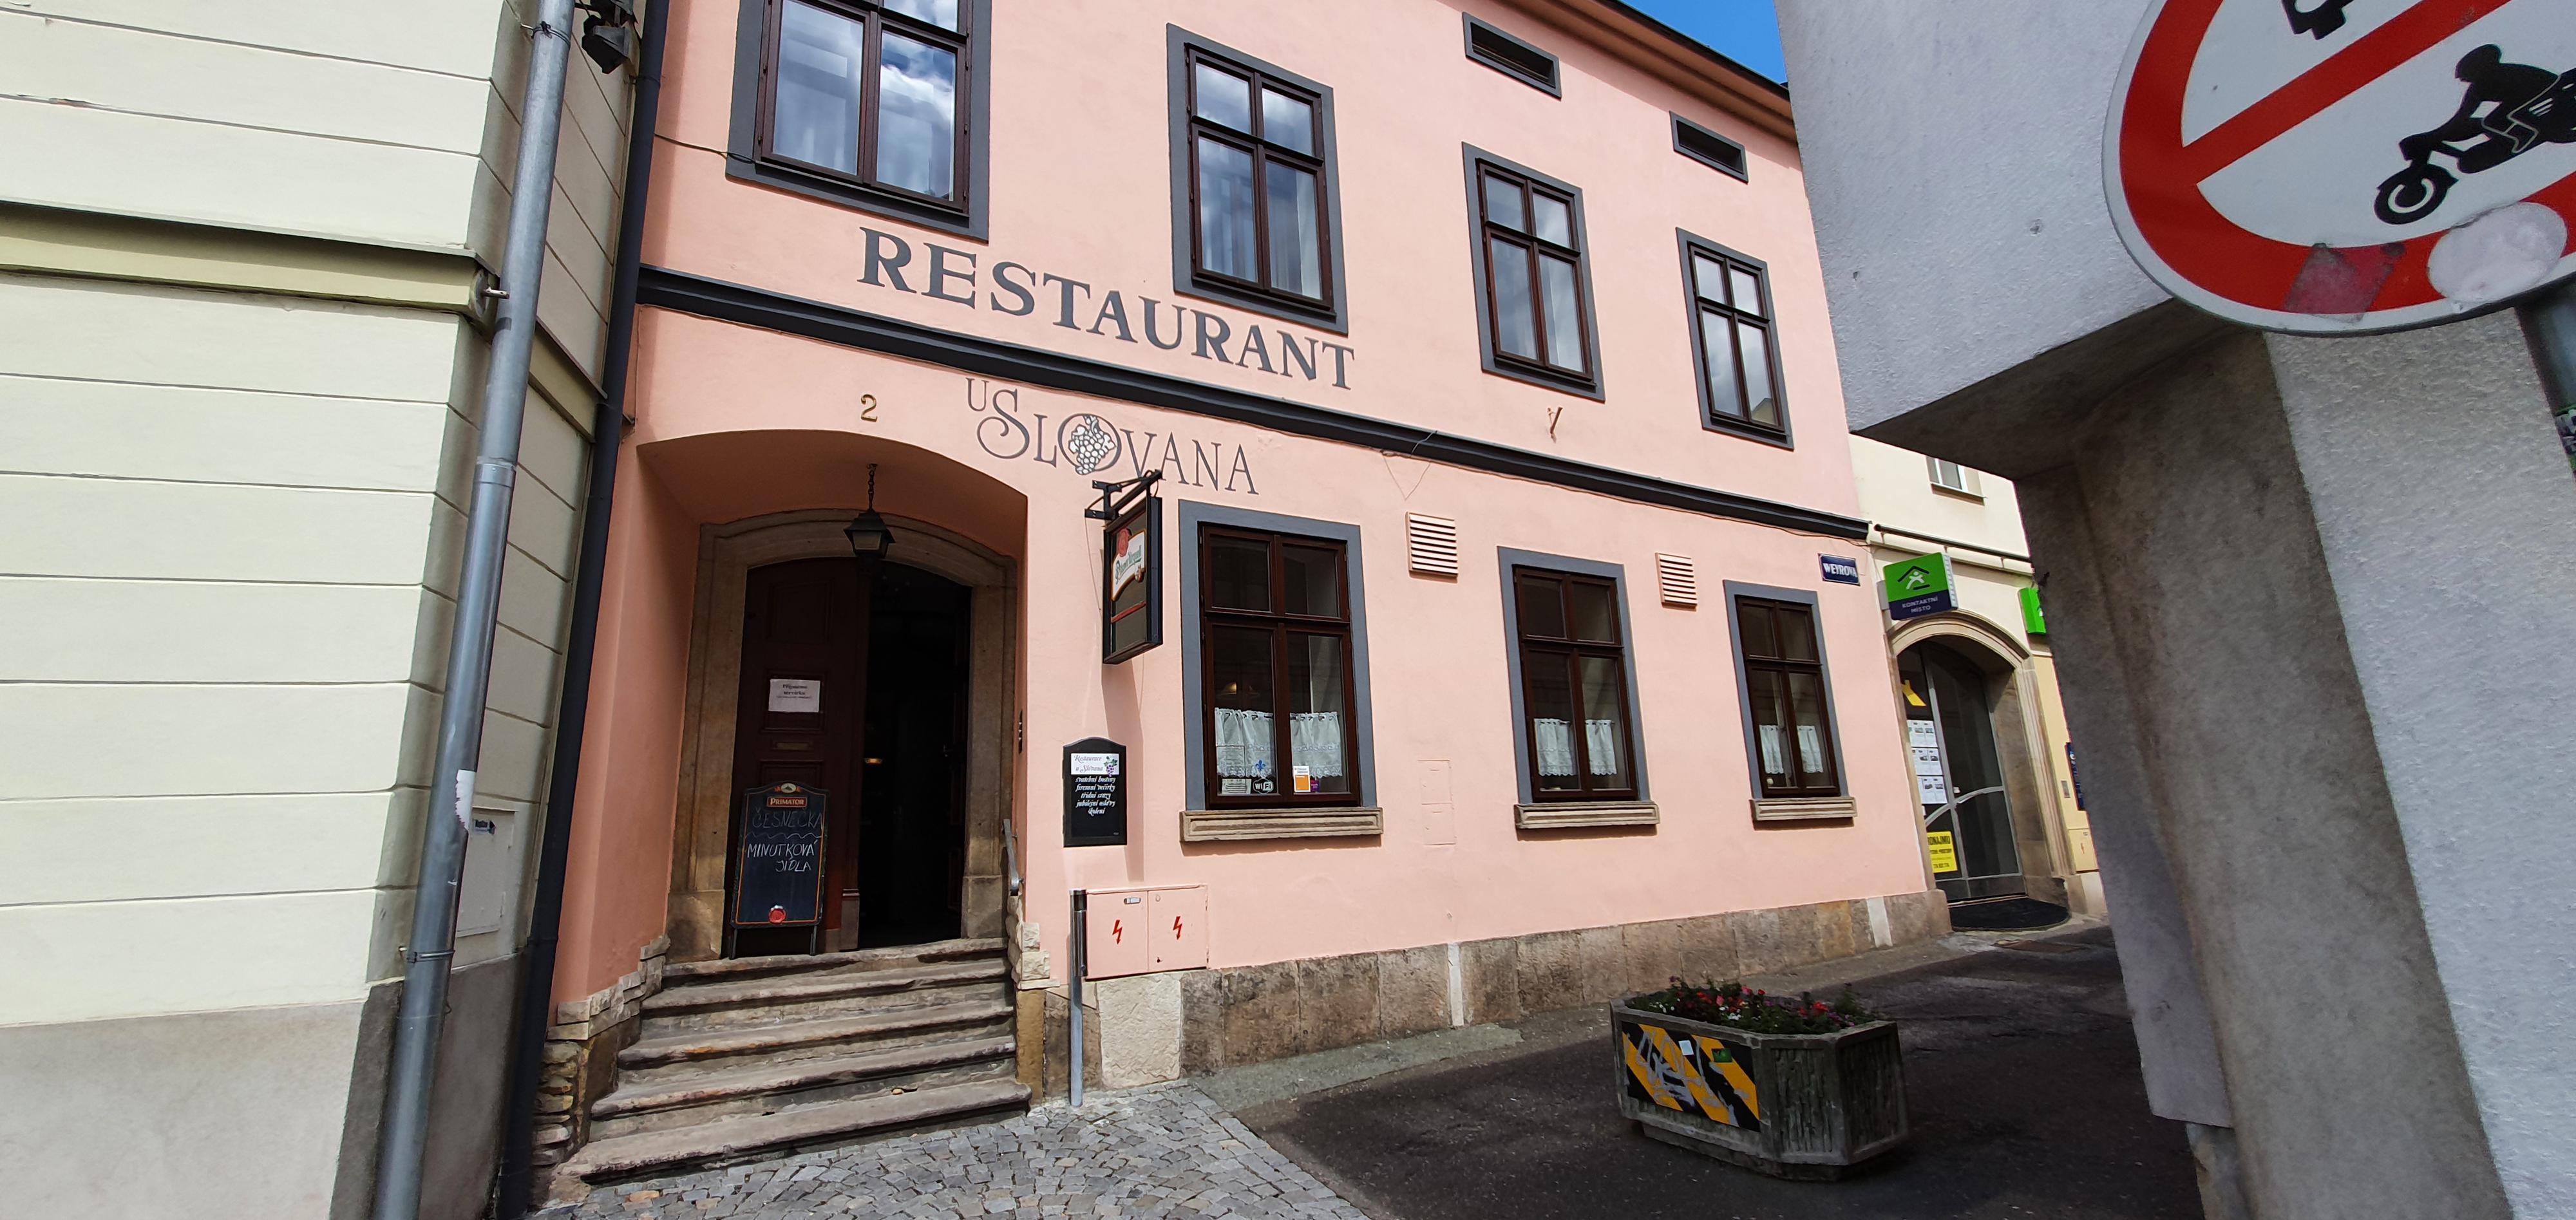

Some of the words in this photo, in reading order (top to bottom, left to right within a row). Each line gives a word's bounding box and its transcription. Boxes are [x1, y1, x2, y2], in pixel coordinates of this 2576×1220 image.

[857, 227, 1356, 391] RESTAURANT
[860, 393, 878, 422] 2
[966, 377, 990, 412] U
[976, 388, 1259, 495] SLOVANA
[1823, 563, 1858, 577] WEYROVA
[1902, 596, 1938, 608] KONTAKTNÍ
[747, 840, 819, 859] MINUTKOVÁ
